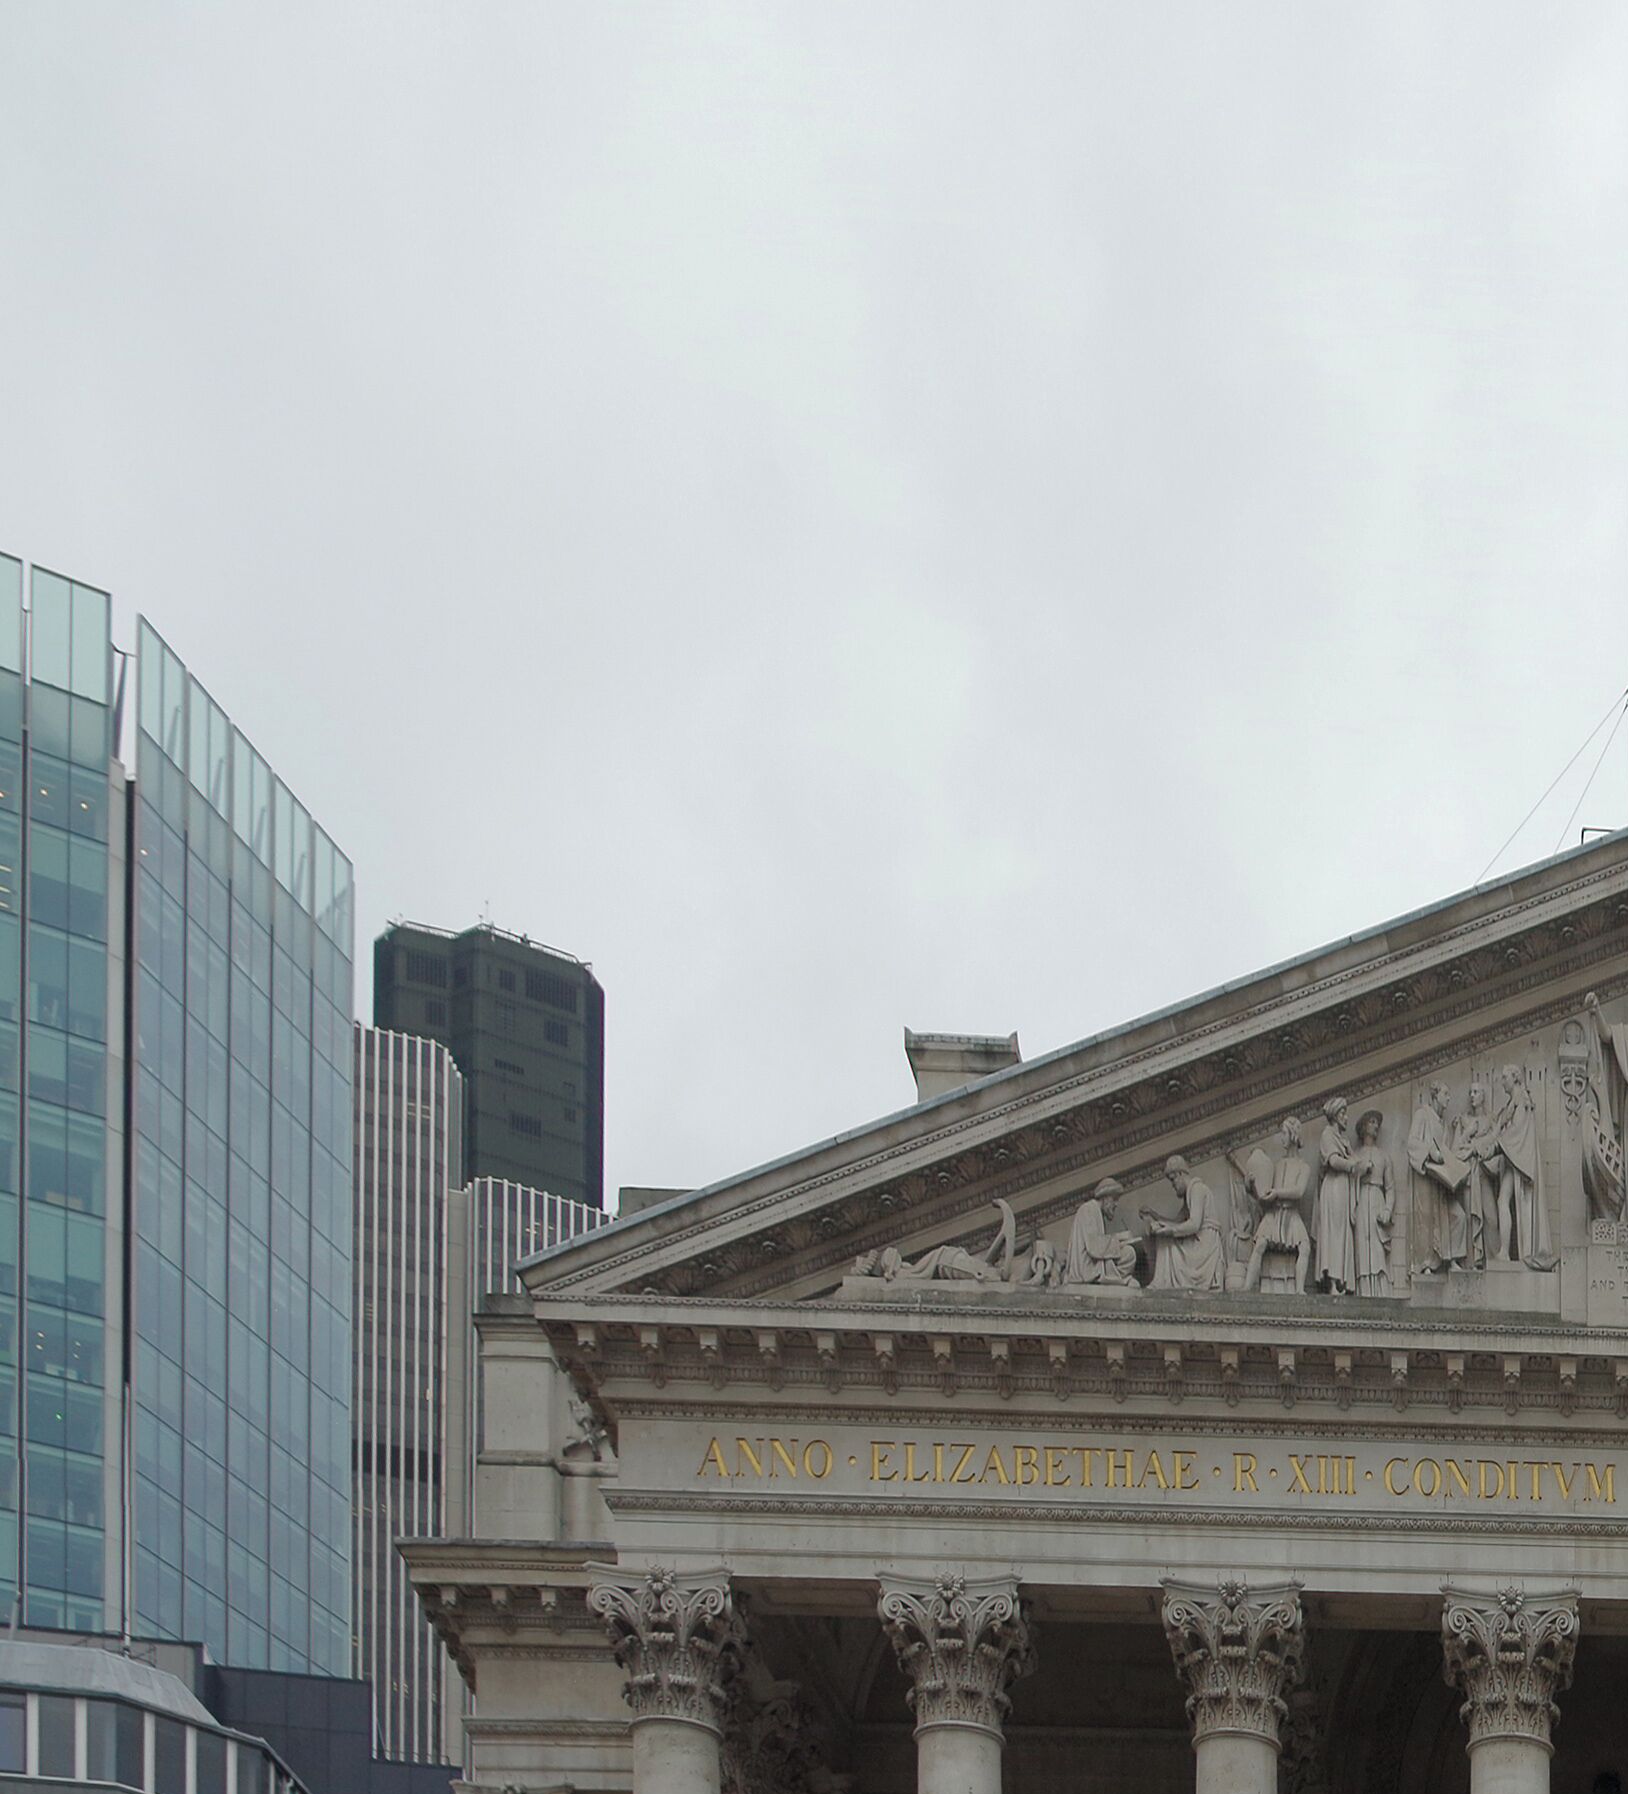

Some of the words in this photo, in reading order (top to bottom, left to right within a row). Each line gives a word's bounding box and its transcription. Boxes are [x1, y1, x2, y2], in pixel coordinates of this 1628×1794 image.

[1590, 1279, 1615, 1291] AND
[697, 1436, 833, 1479] ANNO
[869, 1440, 1200, 1490] ELIZABETHAE
[1231, 1452, 1259, 1492] R
[1287, 1454, 1357, 1495] XIII
[1383, 1457, 1616, 1503] CONDITVM
